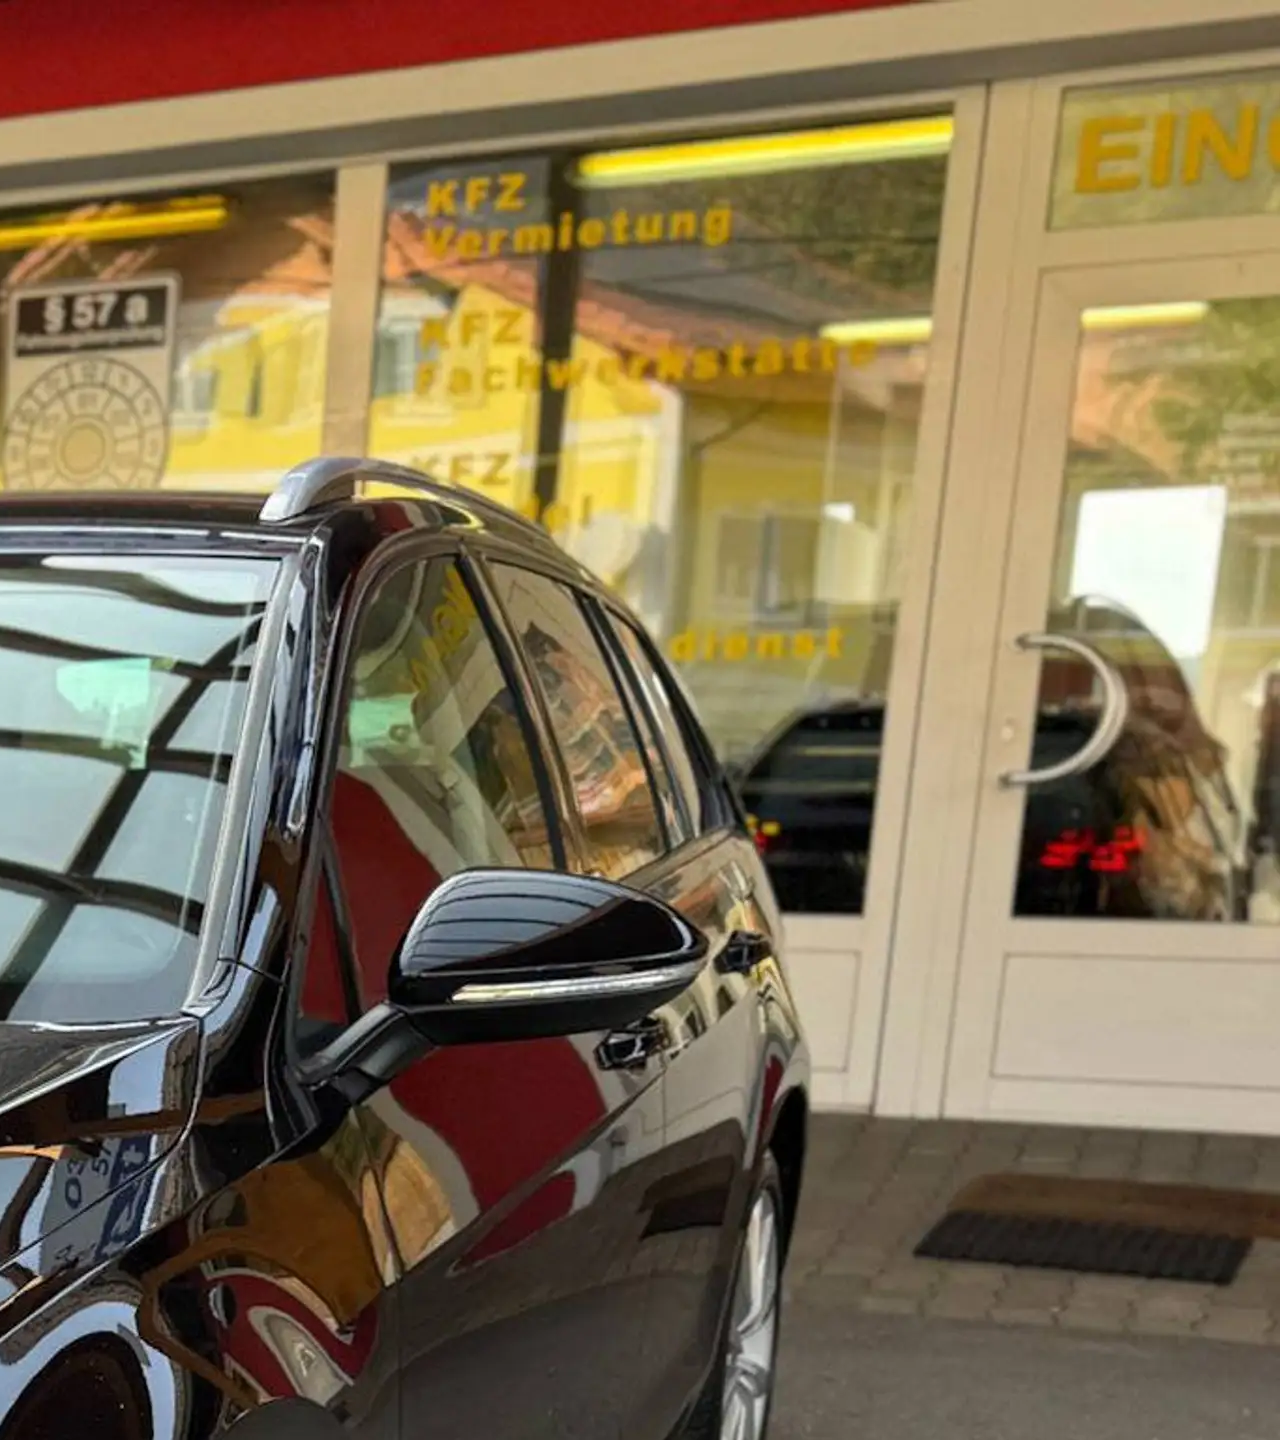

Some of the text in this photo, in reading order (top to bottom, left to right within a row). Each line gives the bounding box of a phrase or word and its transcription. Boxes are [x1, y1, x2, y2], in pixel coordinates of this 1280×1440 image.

[1074, 99, 1280, 194] EIN
[426, 173, 527, 217] KFZ
[422, 207, 734, 259] Vermietung
[71, 292, 118, 329] 57
[418, 310, 524, 350] KFZ
